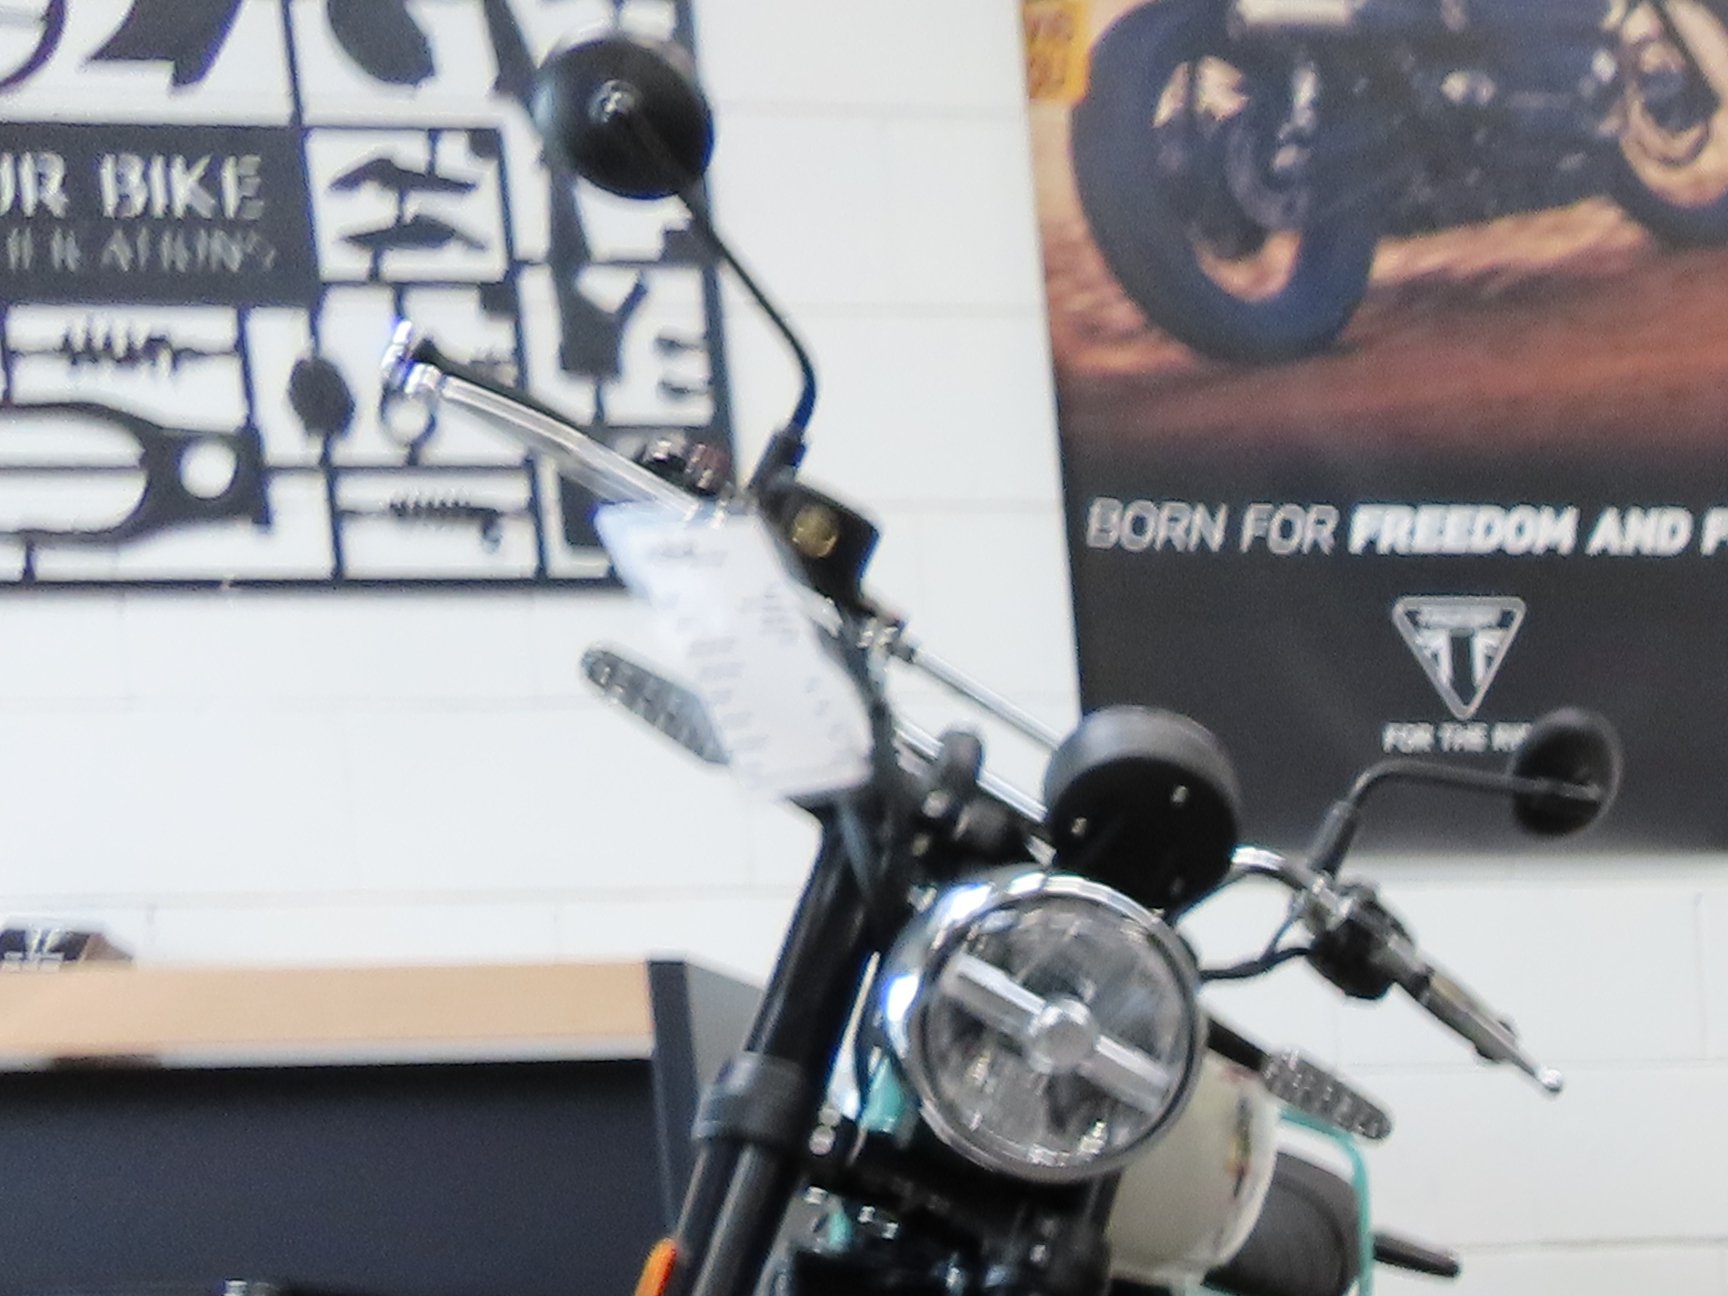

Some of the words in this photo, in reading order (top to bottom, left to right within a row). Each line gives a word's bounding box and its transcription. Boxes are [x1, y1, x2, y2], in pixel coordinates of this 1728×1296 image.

[100, 152, 265, 220] BIKE
[1086, 496, 1228, 553] BORN
[1240, 502, 1341, 554] FOR
[1348, 503, 1580, 556] FREEDOM
[1585, 504, 1694, 556] AND
